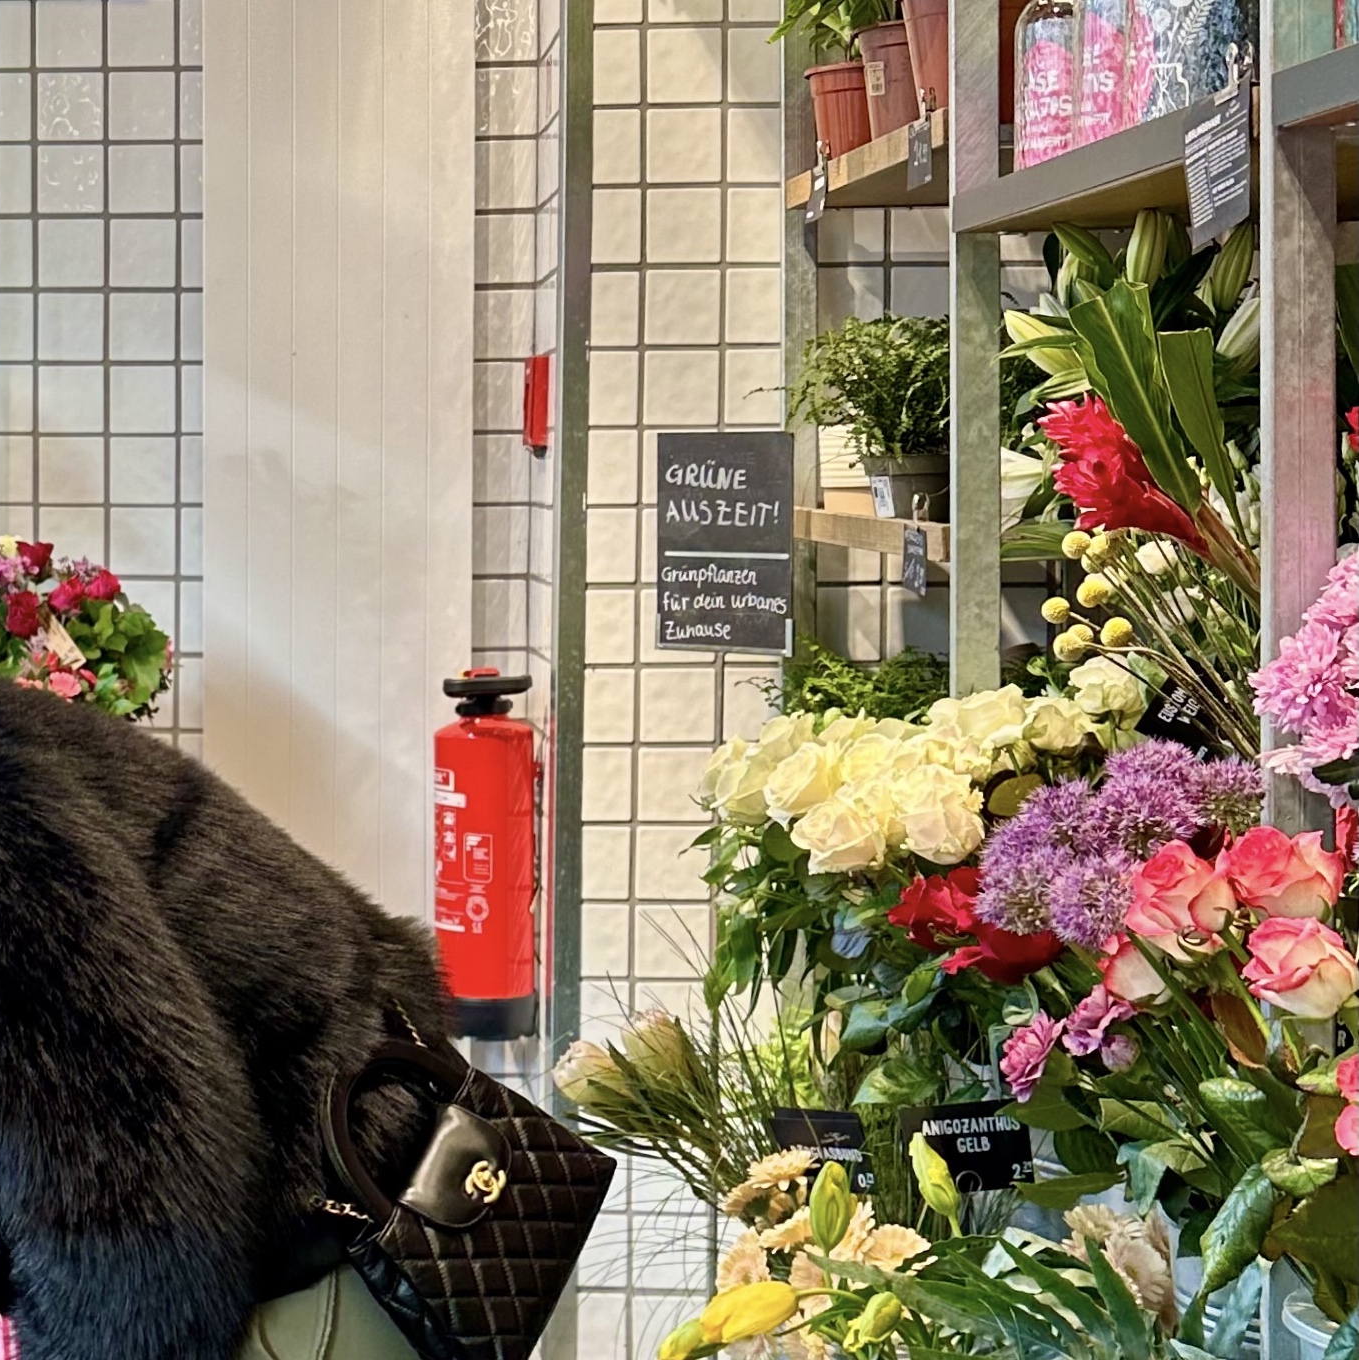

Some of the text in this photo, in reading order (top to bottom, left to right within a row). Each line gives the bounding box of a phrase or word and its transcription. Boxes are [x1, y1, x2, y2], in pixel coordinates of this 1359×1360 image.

[665, 459, 748, 490] GRÜNE
[665, 499, 781, 527] AUSZEIT!
[661, 563, 758, 588] Grünpflanzen
[662, 591, 690, 612] für
[693, 594, 726, 610] dein
[664, 620, 732, 641] Zuhause
[922, 1115, 1021, 1138] ANIGOZANTHUS
[956, 1136, 992, 1154] GELB
